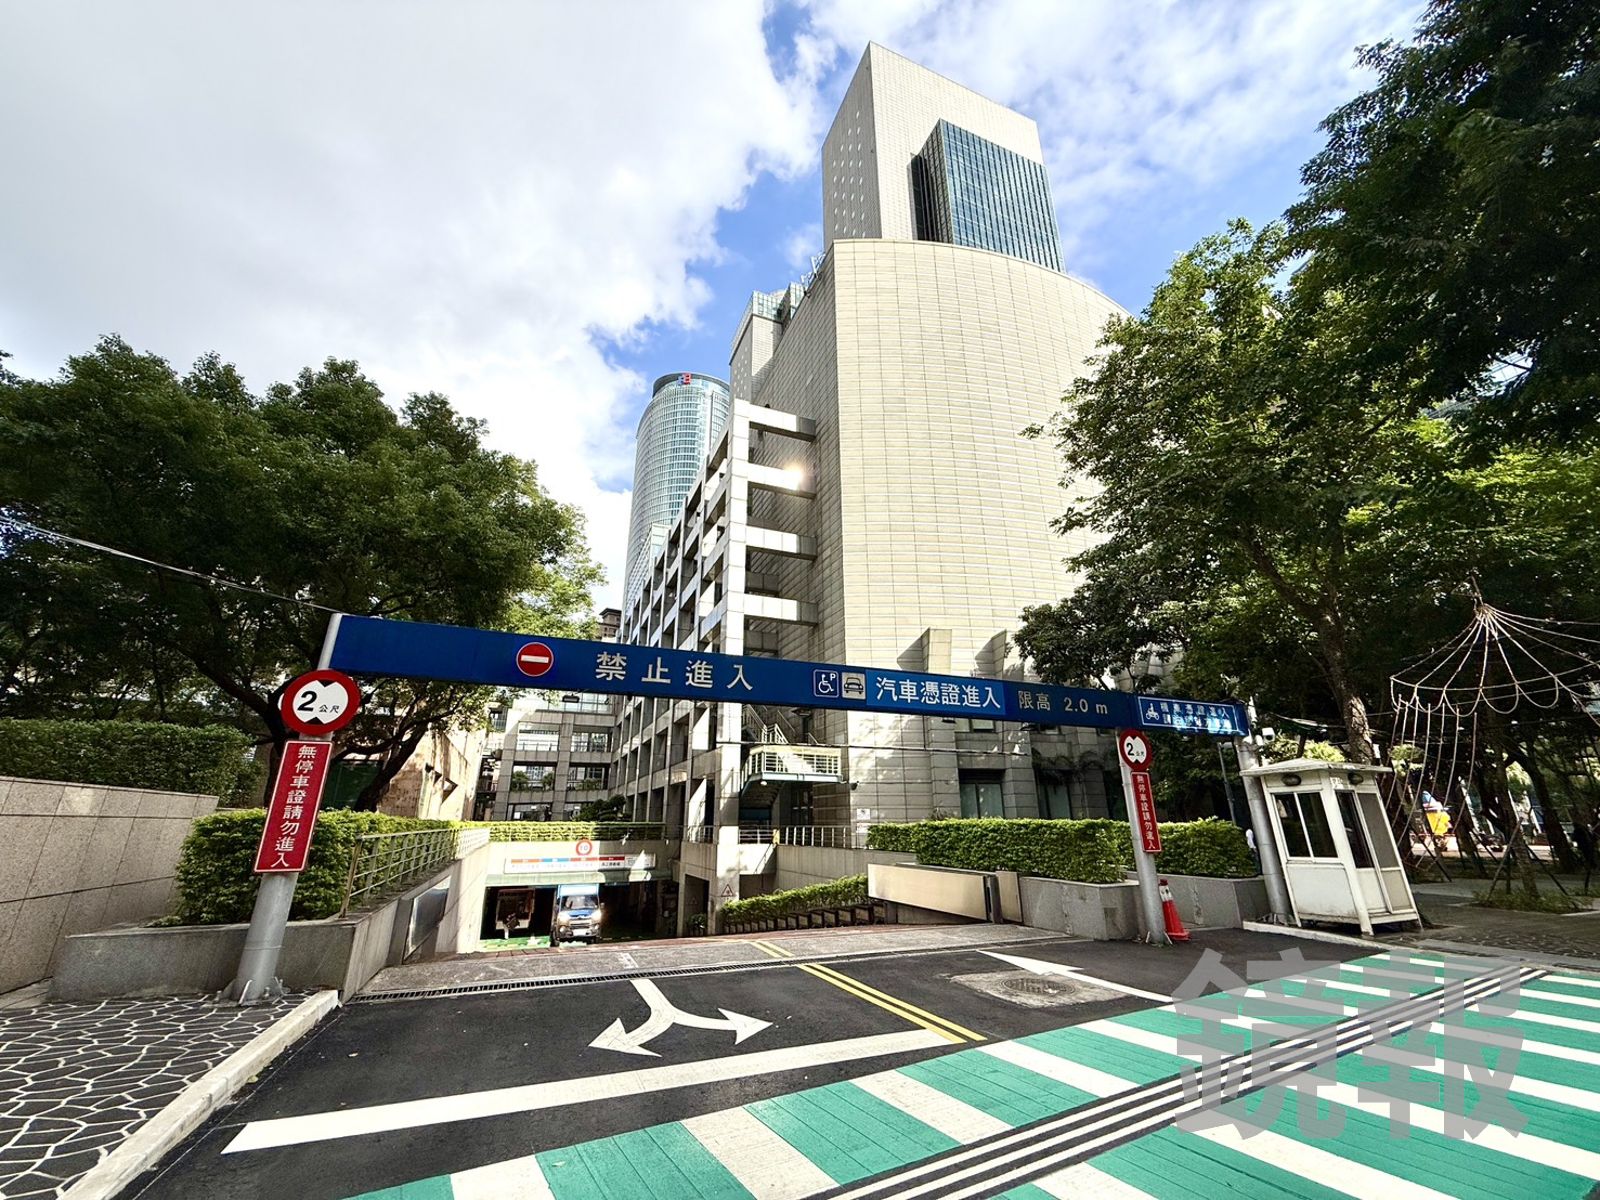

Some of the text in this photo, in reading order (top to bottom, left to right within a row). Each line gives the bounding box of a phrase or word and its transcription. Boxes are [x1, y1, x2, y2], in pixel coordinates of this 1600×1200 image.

[595, 650, 754, 691] 禁止進入
[297, 690, 339, 714] 2 公尺
[876, 676, 1001, 709] 汽車憑證進入
[1018, 690, 1108, 715] 限高 2.0 m
[1126, 742, 1134, 756] 2
[271, 744, 318, 868] 無停車證請勿進入
